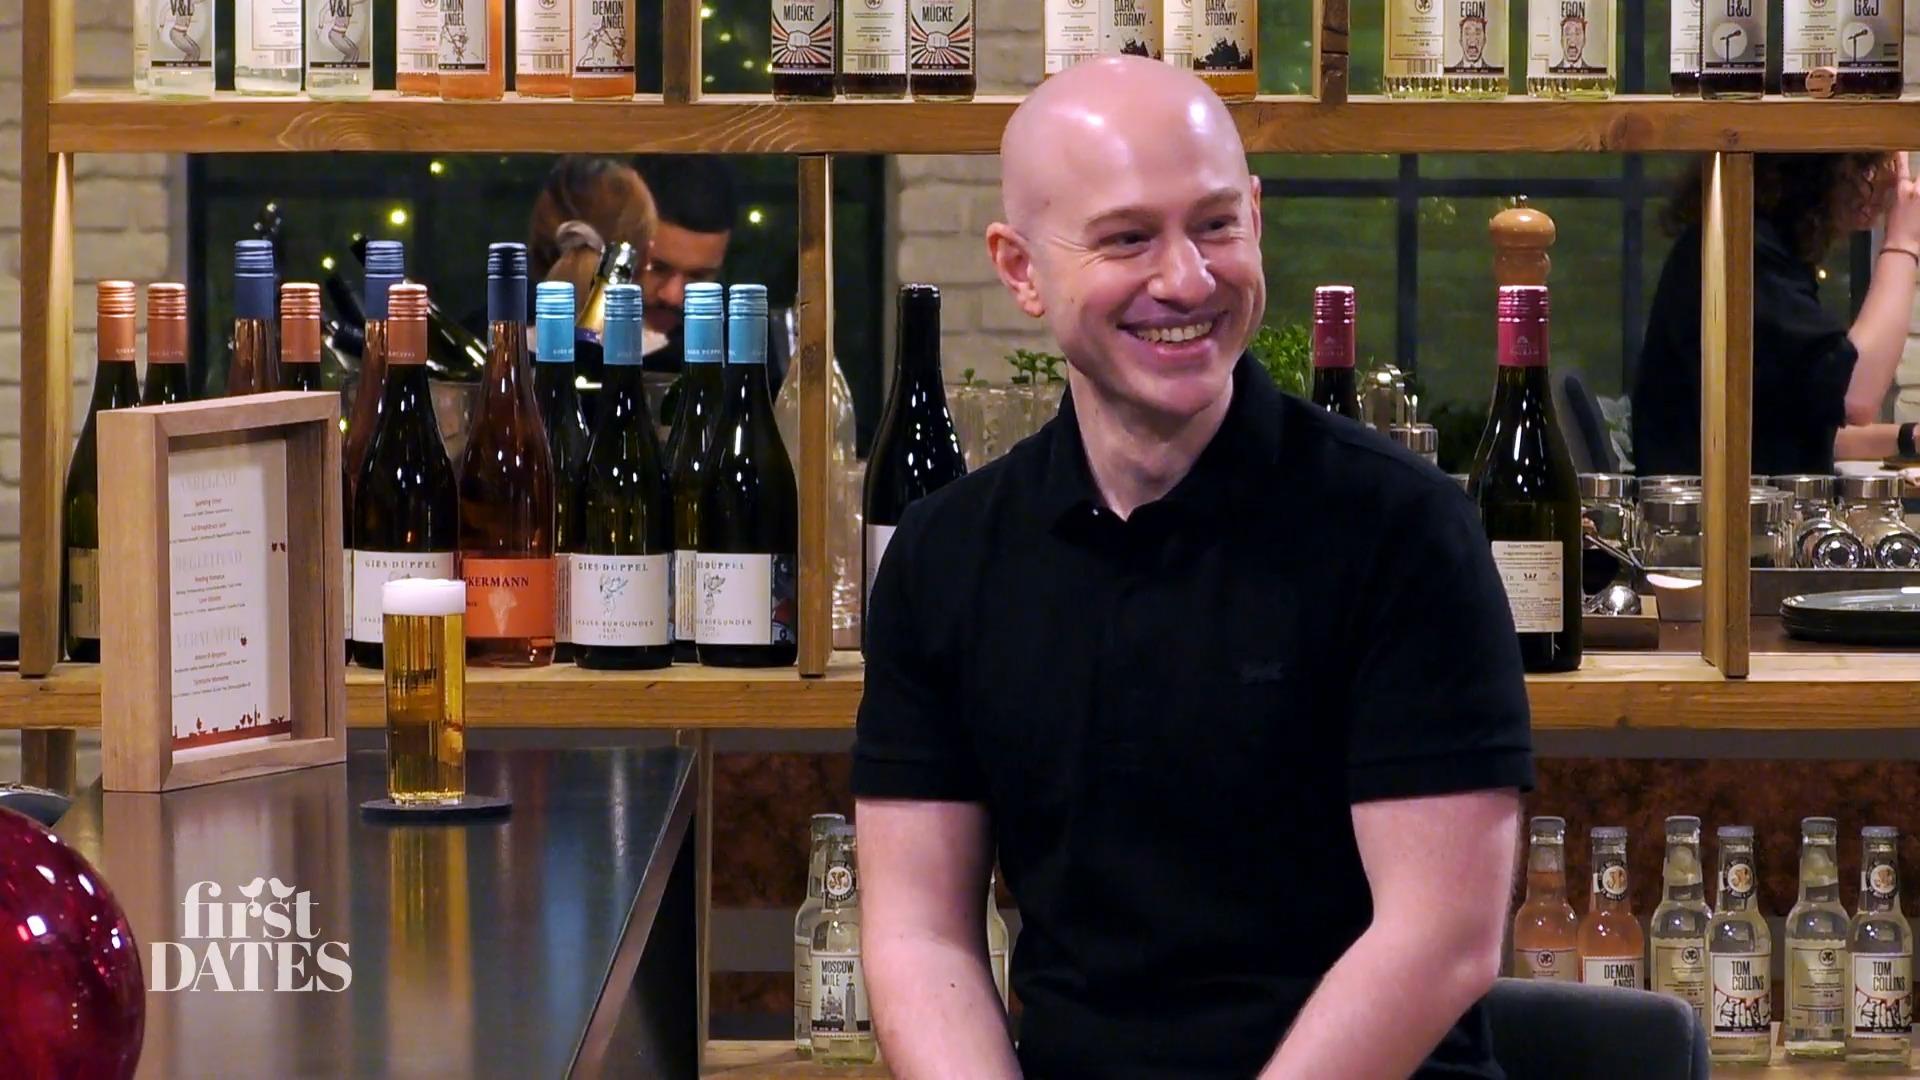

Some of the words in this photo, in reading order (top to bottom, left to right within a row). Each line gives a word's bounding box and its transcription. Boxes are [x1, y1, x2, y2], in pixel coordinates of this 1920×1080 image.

[592, 1, 624, 15] DEMON
[783, 4, 815, 21] MÜCKE
[922, 5, 953, 22] MÜCKE
[1460, 1, 1486, 17] EGON
[1561, 1, 1586, 17] EGON
[601, 15, 625, 29] ANGEL
[1114, 13, 1146, 26] STORMY
[1205, 12, 1237, 26] STORMY
[465, 576, 529, 587] KERMANN
[821, 960, 855, 973] MOSCOW
[1604, 964, 1635, 979] DEMON
[1732, 960, 1750, 975] TOM
[1873, 961, 1891, 975] TOM
[821, 974, 840, 987] MULE
[1732, 975, 1764, 991] COLLINS
[1873, 976, 1905, 991] COLLINS
